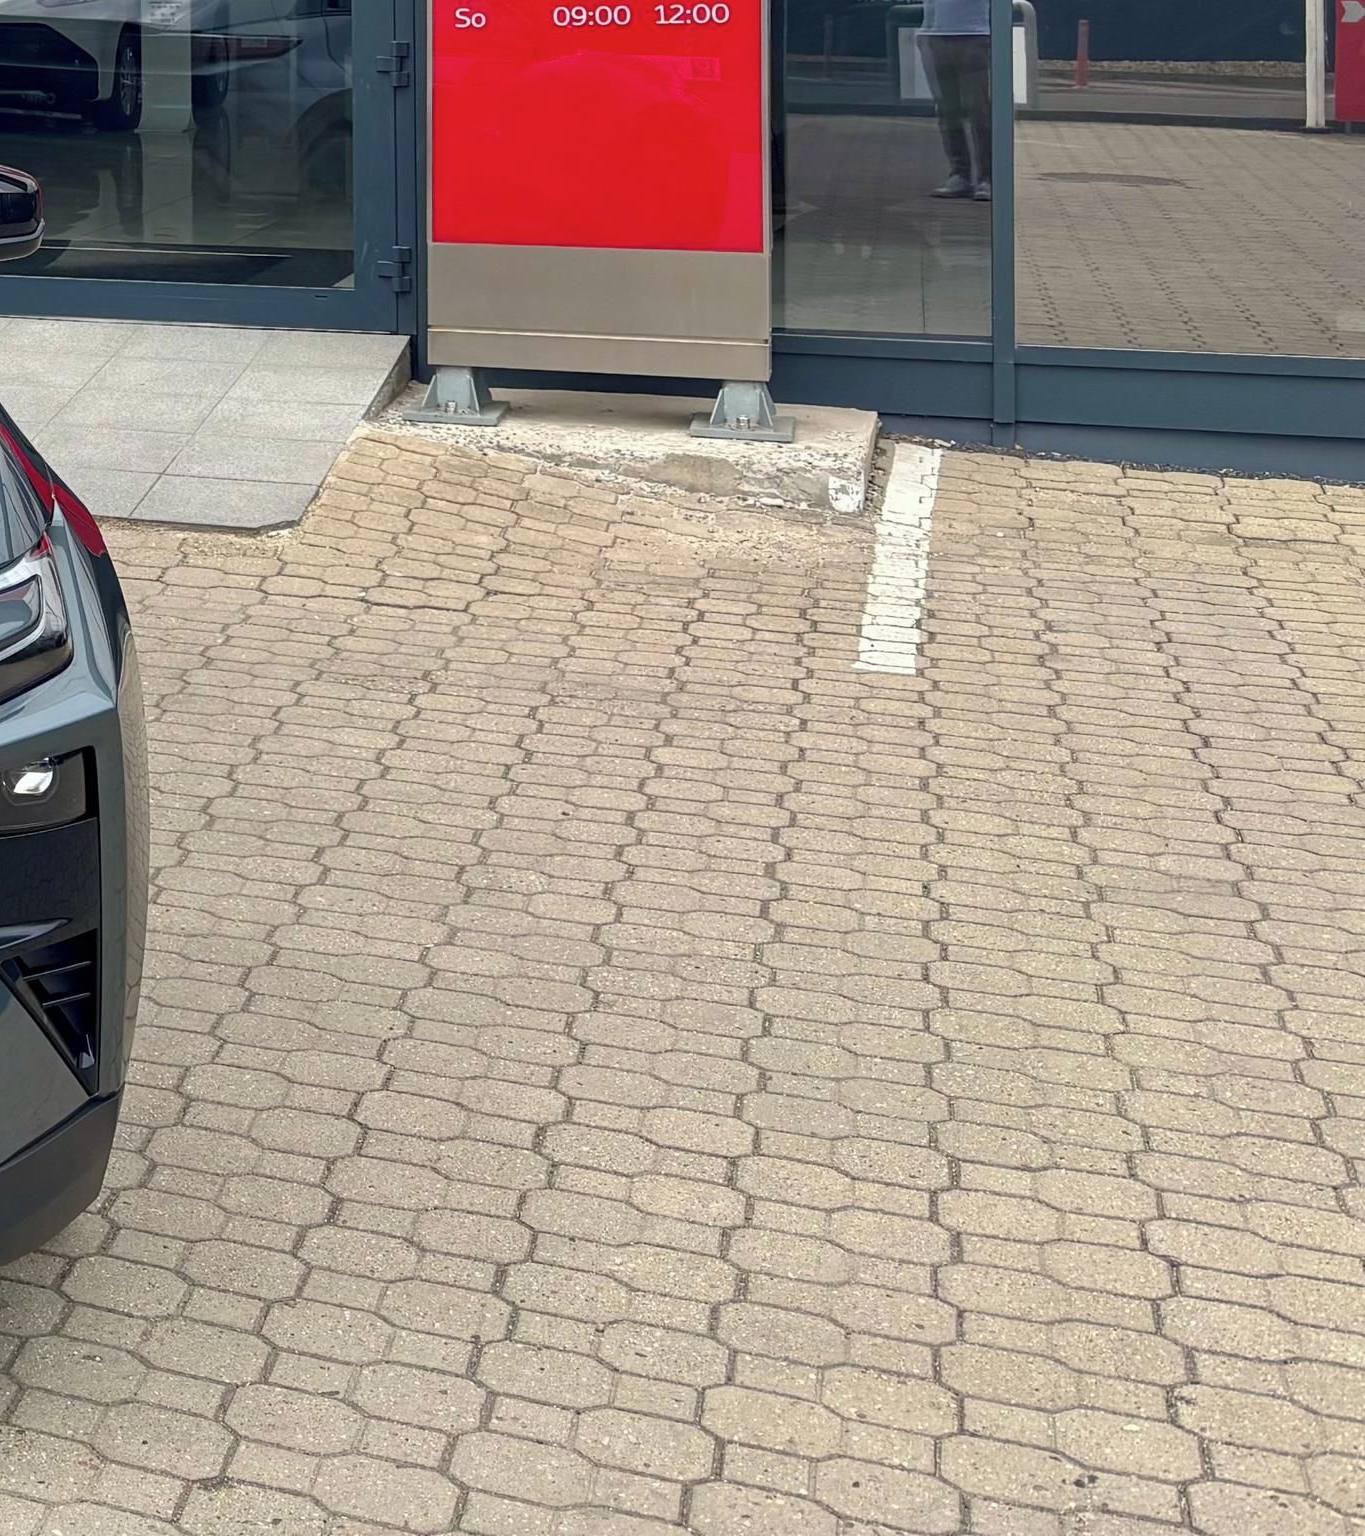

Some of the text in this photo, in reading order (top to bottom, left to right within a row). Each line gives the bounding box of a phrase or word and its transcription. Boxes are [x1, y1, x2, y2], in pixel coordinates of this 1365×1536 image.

[454, 3, 730, 29] So 09:00 12:00
